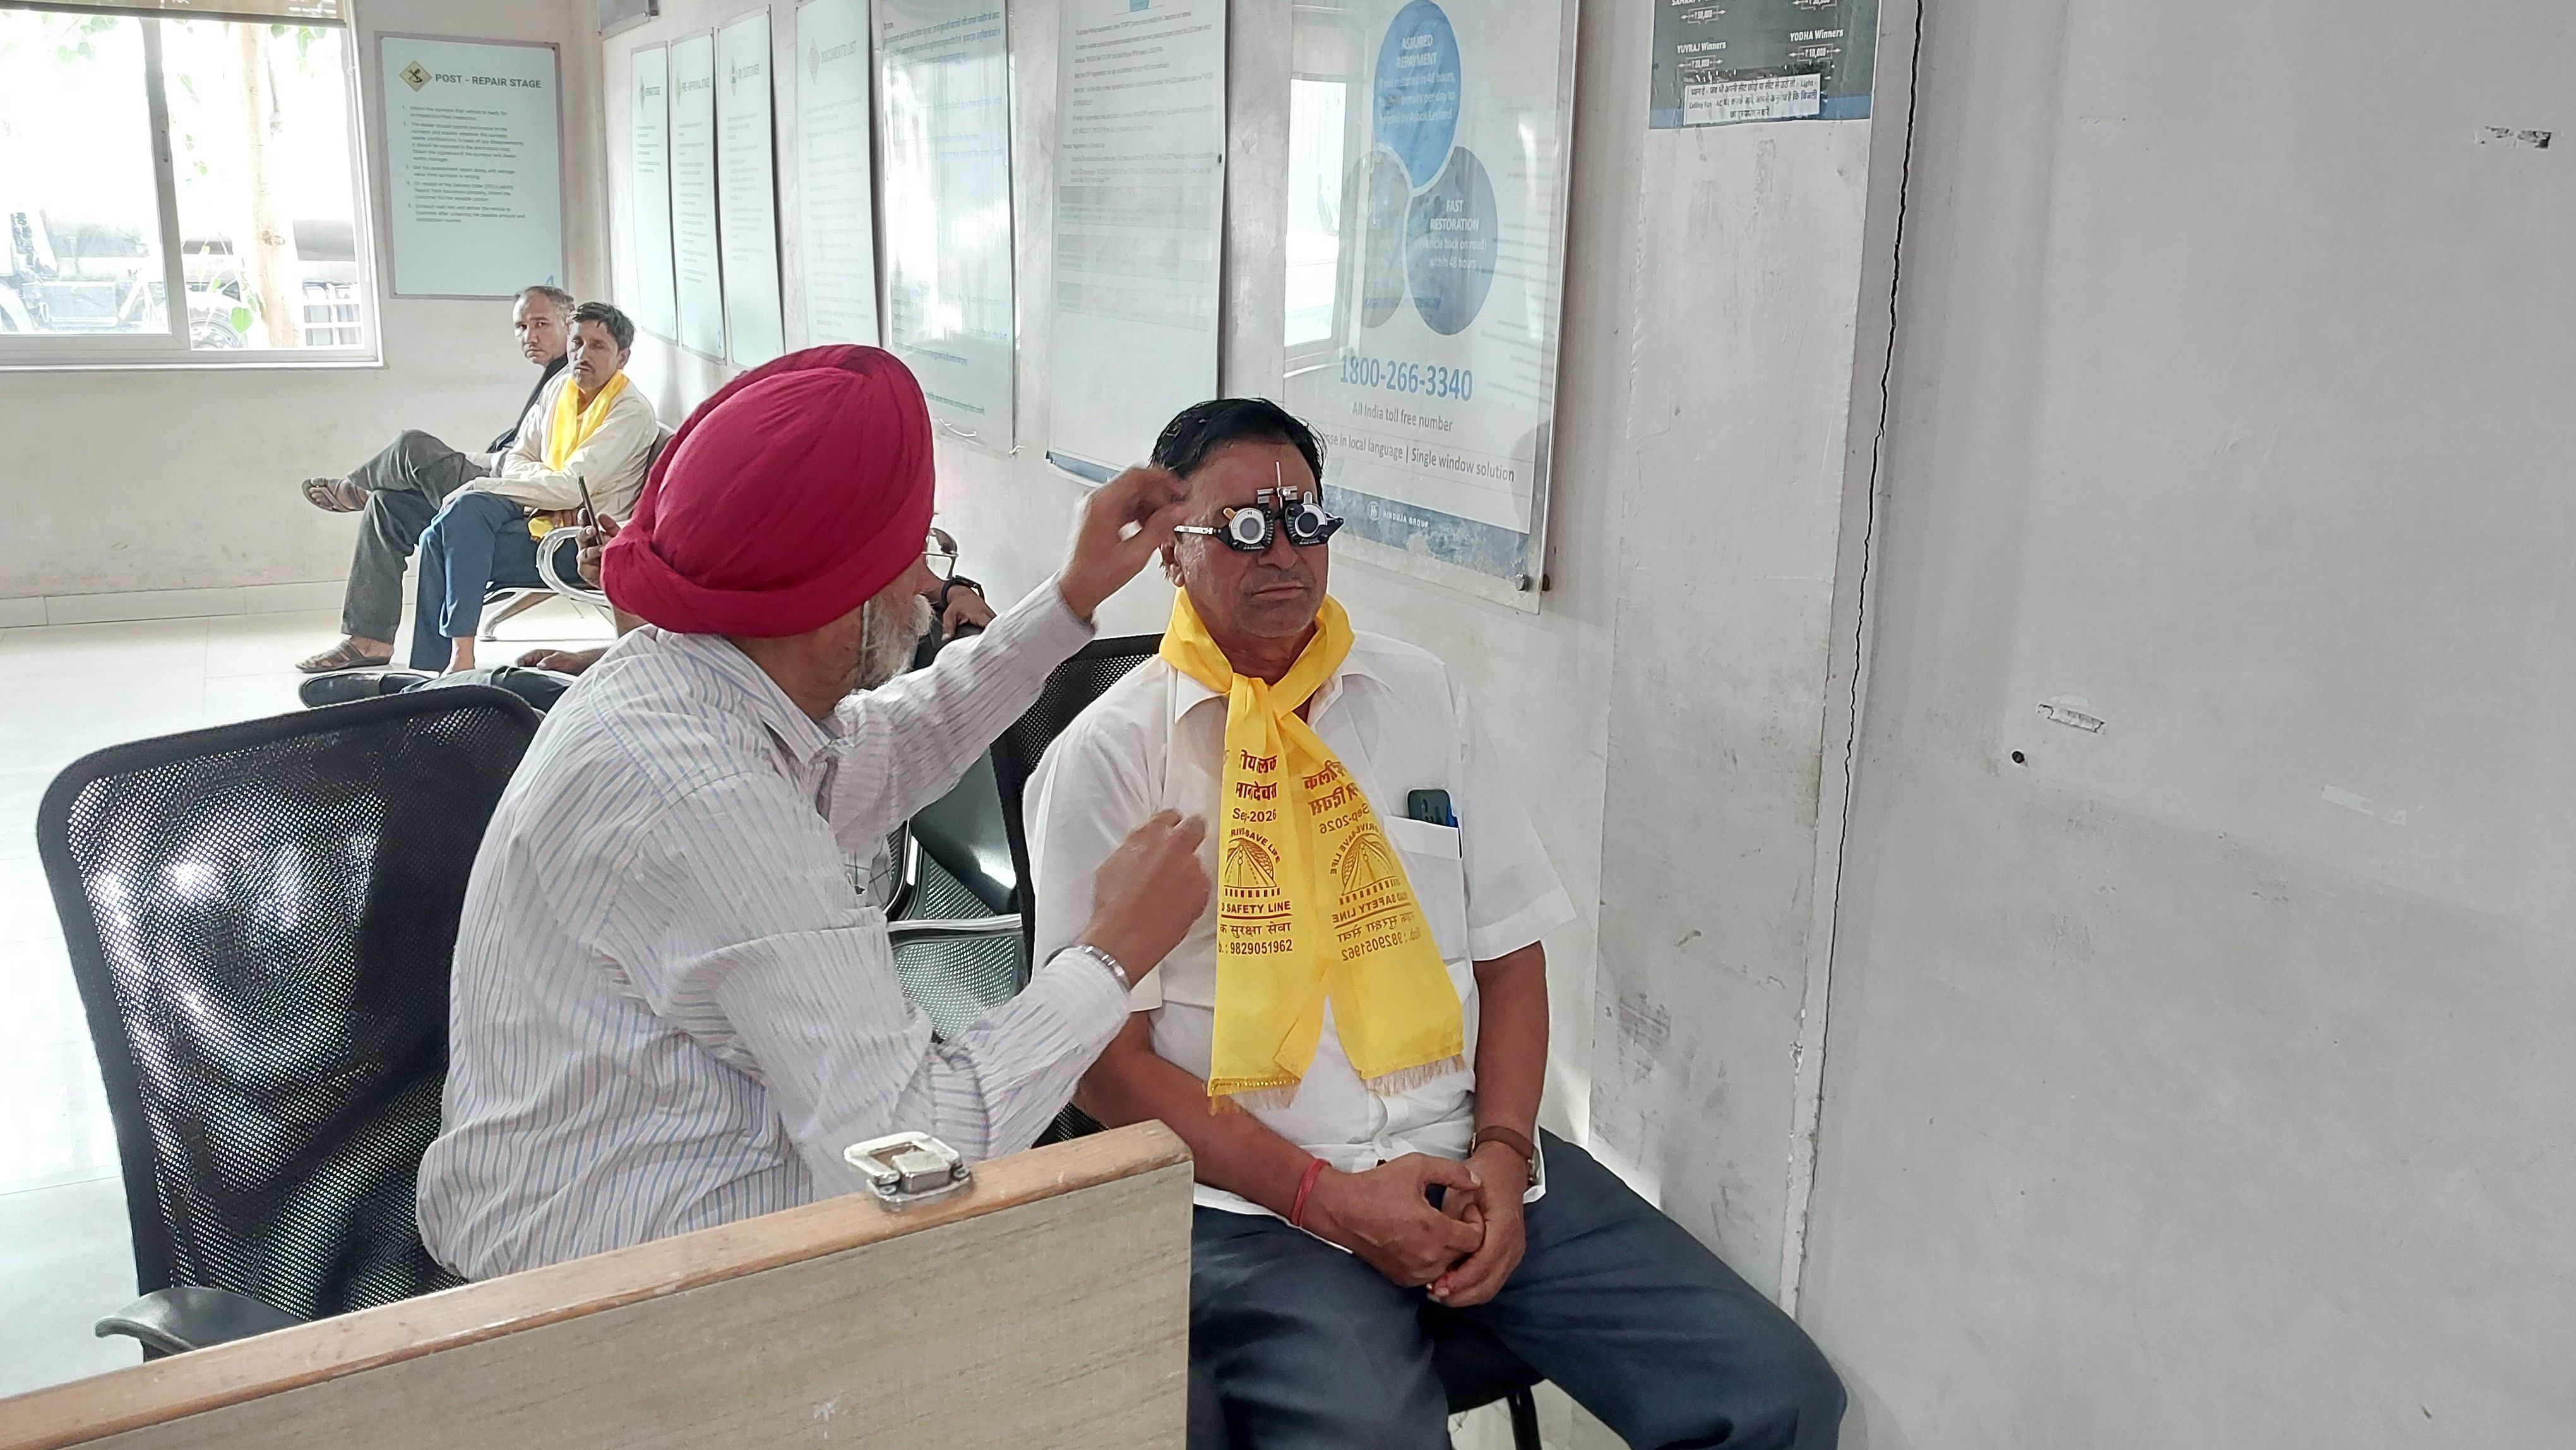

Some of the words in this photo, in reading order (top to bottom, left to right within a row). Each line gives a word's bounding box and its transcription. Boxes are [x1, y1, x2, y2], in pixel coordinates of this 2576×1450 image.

[1402, 34, 1433, 50] ASSURED
[1790, 31, 1813, 42] YODHA
[1815, 28, 1844, 40] Winners
[1677, 44, 1700, 54] YUVRAJ
[1702, 41, 1726, 51] Winners
[435, 73, 462, 83] POST
[472, 76, 507, 87] REPAIR
[510, 78, 542, 88] STAGE
[1801, 80, 1813, 88] Light
[1446, 200, 1464, 212] FAST
[1430, 218, 1479, 231] RESTORATION
[1340, 355, 1473, 402] 1800-266-3340
[1352, 402, 1363, 416] All
[1364, 404, 1383, 420] India
[1385, 407, 1398, 423] toll
[1400, 409, 1417, 426] free
[1419, 415, 1453, 433] number
[1340, 434, 1347, 446] in
[1349, 434, 1366, 451] local
[1368, 438, 1403, 461] language
[1411, 447, 1436, 467] Single
[1439, 455, 1474, 473] window
[1476, 462, 1514, 482] solution
[1409, 517, 1428, 528] GROUP
[1227, 903, 1264, 914] SAFETY
[1268, 901, 1291, 913] LINE
[1230, 925, 1262, 938] सुरक्षा
[1267, 921, 1292, 935] सेवा
[1231, 938, 1293, 955] 9829051962
